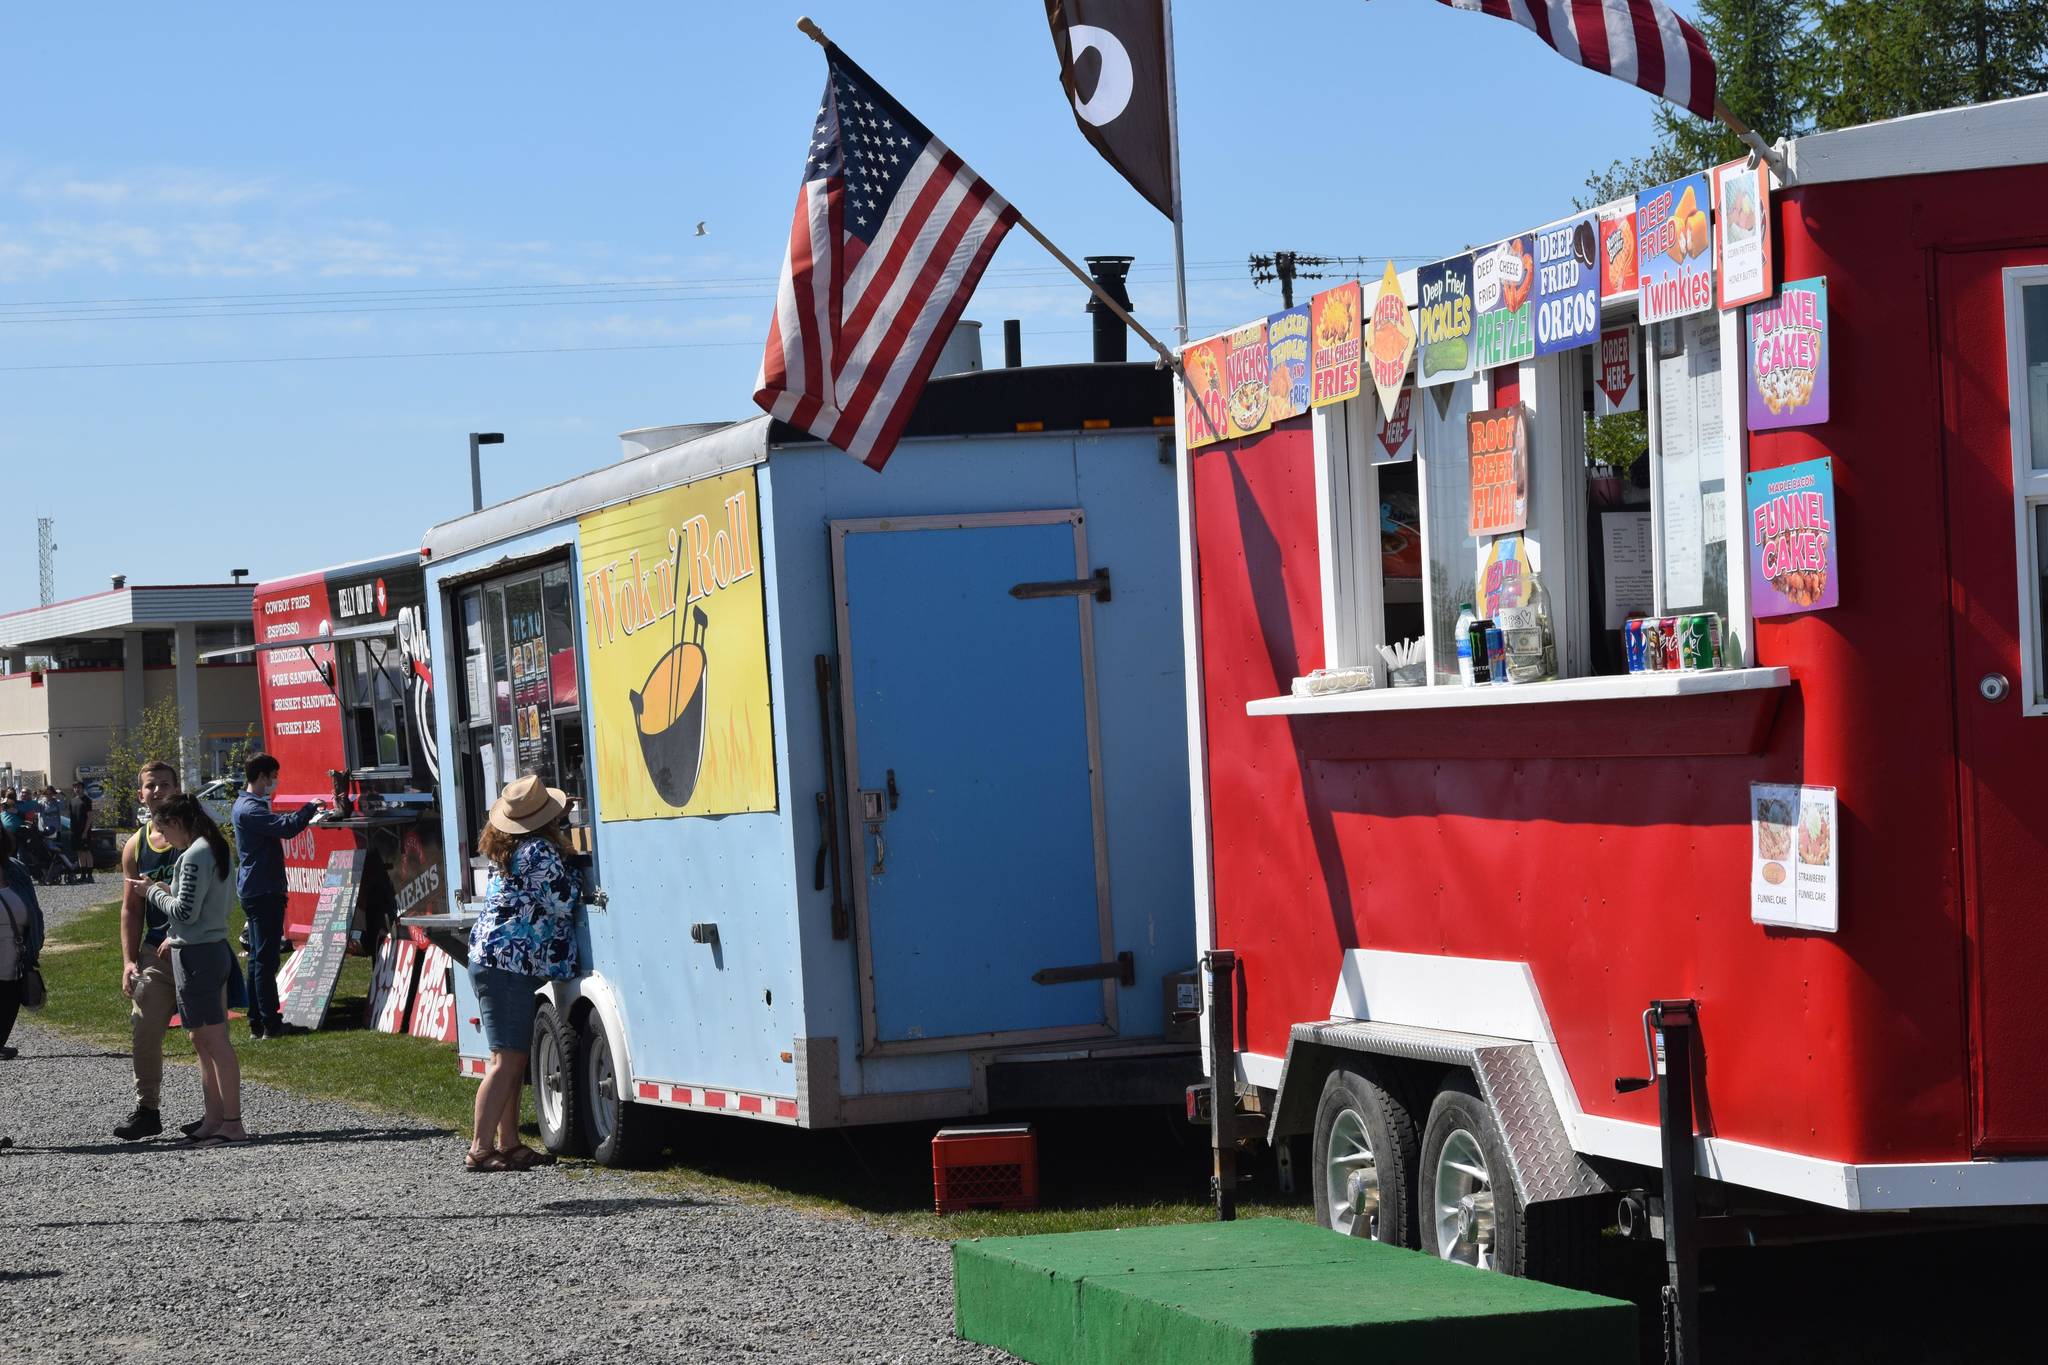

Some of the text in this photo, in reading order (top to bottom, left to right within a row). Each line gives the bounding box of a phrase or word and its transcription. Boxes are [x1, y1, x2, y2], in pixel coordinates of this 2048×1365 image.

[1639, 190, 1673, 236] DEEP
[1539, 225, 1574, 263] DEEP
[1640, 218, 1677, 266] FRIED
[1477, 259, 1494, 280] DEEP
[1499, 260, 1519, 277] CHEESE
[1540, 259, 1579, 296] FRIED
[1423, 270, 1466, 307] Deep Fried
[1478, 283, 1497, 306] FRIED
[1641, 264, 1711, 320] Twinkies
[1270, 313, 1309, 346] CHICKEN
[1374, 294, 1405, 331] CHEESE
[1420, 294, 1471, 347] PICKLES
[1537, 290, 1596, 345] OREOS
[1751, 288, 1824, 342] FUNNEL
[1315, 337, 1360, 370] CHILI CHEESE
[1475, 301, 1535, 370] PRETZEL
[1603, 336, 1629, 365] ORDER
[1226, 343, 1269, 392] NACHOS
[1293, 363, 1306, 379] AND
[1375, 351, 1405, 388] FRIES
[1757, 332, 1817, 377] CAKES
[1289, 383, 1310, 408] FRIES
[1314, 359, 1359, 402] FRIES
[1606, 364, 1627, 392] HERE
[1188, 389, 1228, 445] TACOS
[1385, 420, 1405, 444] HERE
[1472, 416, 1515, 454] ROOT
[1472, 450, 1514, 486] BEER
[1768, 474, 1815, 495] MAPLE BACON
[1472, 481, 1517, 530] FLOAT
[1753, 491, 1830, 546] FUNNEL
[586, 548, 656, 648] Wok
[682, 490, 754, 605] Roll
[1761, 533, 1826, 580] CAKES
[265, 594, 311, 615] COWBOY FRIES
[356, 585, 366, 615] ON
[364, 583, 373, 614] UP
[267, 621, 300, 639] ESPRESSO
[512, 611, 542, 641] MENU
[269, 647, 302, 664] REINDEER
[272, 673, 290, 687] PORK
[274, 693, 337, 712] BRISKET SANDWICH
[276, 720, 321, 736] TURKEY LEGS
[395, 863, 440, 918] MEATS
[1798, 872, 1827, 884] STRAWBERRY
[1757, 894, 1787, 906] FUNNEL CAKE
[1798, 890, 1827, 903] FUNNEL CAKE
[413, 990, 454, 1041] FRIES
